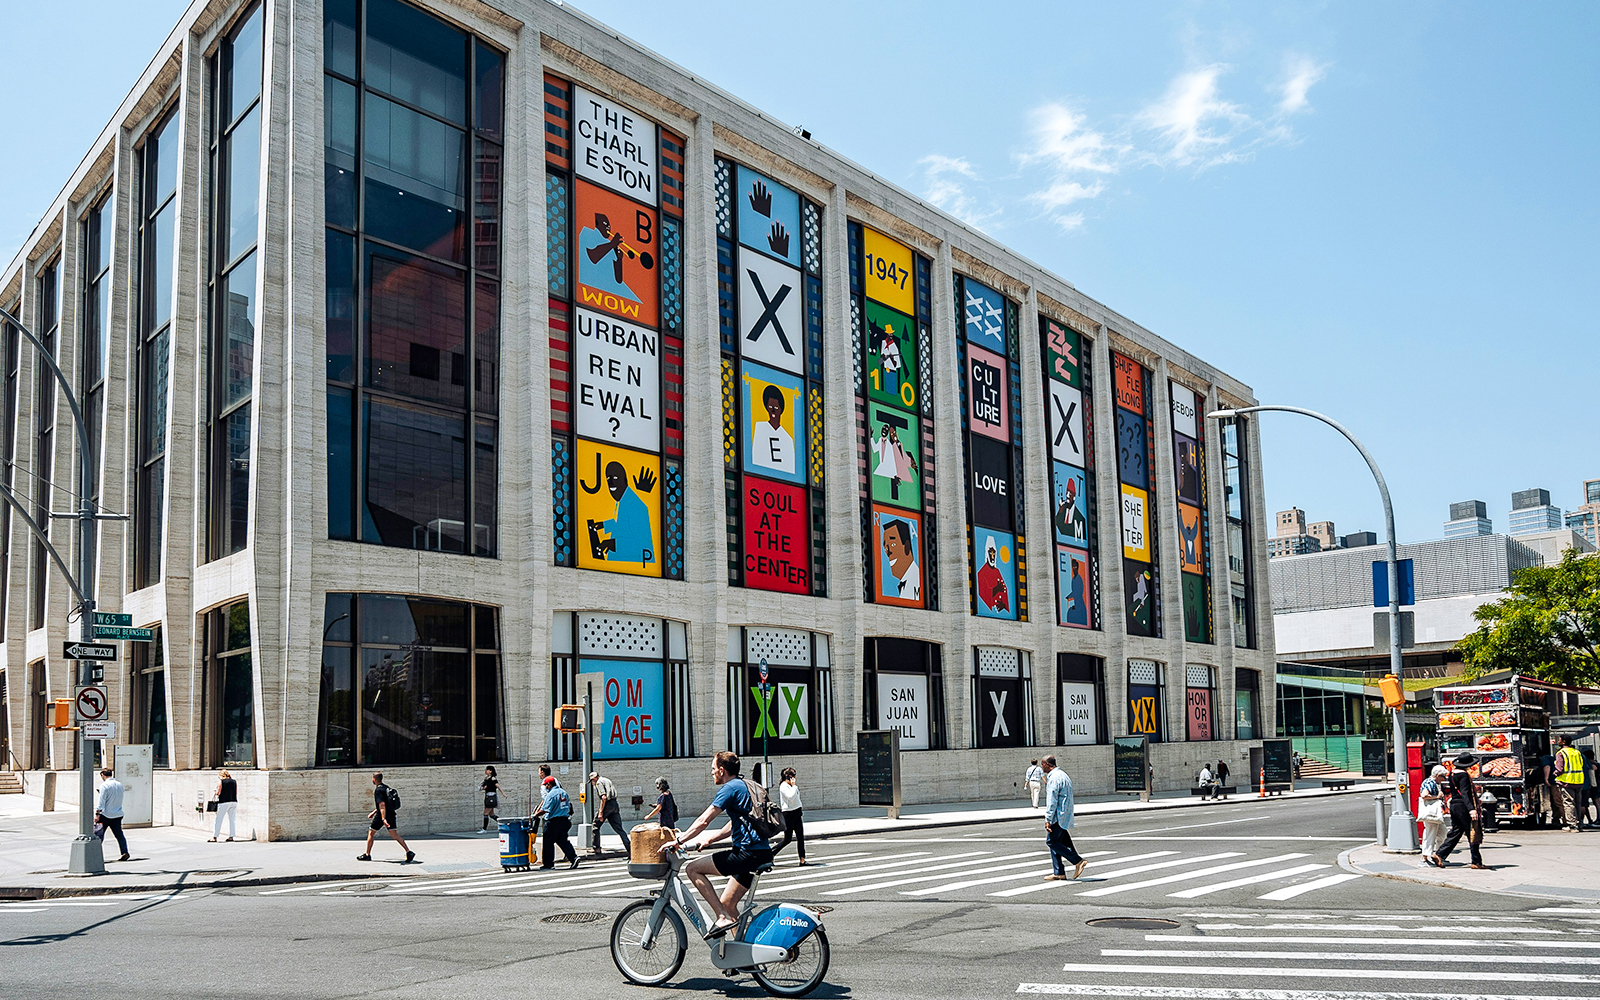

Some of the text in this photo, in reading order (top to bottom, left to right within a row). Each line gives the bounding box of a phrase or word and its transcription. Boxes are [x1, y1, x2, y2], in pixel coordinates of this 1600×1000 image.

[590, 100, 633, 137] THE
[578, 120, 648, 167] CHARL
[586, 147, 651, 193] ESTON
[636, 210, 652, 244] B
[866, 253, 908, 290] 1947
[582, 287, 639, 318] WOW
[746, 268, 795, 356] X
[578, 314, 656, 357] URBAN
[589, 353, 641, 387] REN
[974, 366, 992, 386] CU
[982, 384, 998, 404] LT
[1126, 376, 1140, 394] FLE
[580, 384, 652, 420] EWAL
[1117, 388, 1140, 408] ALONG
[976, 401, 1000, 424] URE
[1052, 392, 1080, 454] X
[608, 417, 620, 438] ?
[769, 438, 782, 463] E
[1190, 443, 1196, 467] H
[580, 452, 602, 494] J
[975, 472, 1006, 496] LOVE
[1076, 474, 1084, 497] T
[750, 488, 798, 514] SOUL
[1124, 500, 1142, 517] SHE
[760, 512, 782, 531] AT
[873, 511, 880, 527] R
[909, 520, 918, 540] A
[1132, 516, 1137, 530] L
[754, 530, 791, 553] THE
[1074, 520, 1084, 543] M
[1125, 529, 1142, 546] TER
[642, 548, 652, 569] P
[746, 554, 807, 586] CENTER
[1060, 552, 1066, 572] E
[891, 688, 915, 702] SAN
[1070, 694, 1087, 705] SAN
[1188, 692, 1206, 706] HON
[886, 707, 918, 720] JUAN
[989, 690, 1010, 738] X
[1068, 709, 1089, 720] JUAN
[1195, 706, 1207, 721] OR
[610, 715, 652, 745] AGE
[890, 726, 916, 738] ILL
[1070, 724, 1088, 736] HILL
[792, 918, 808, 928] bike
